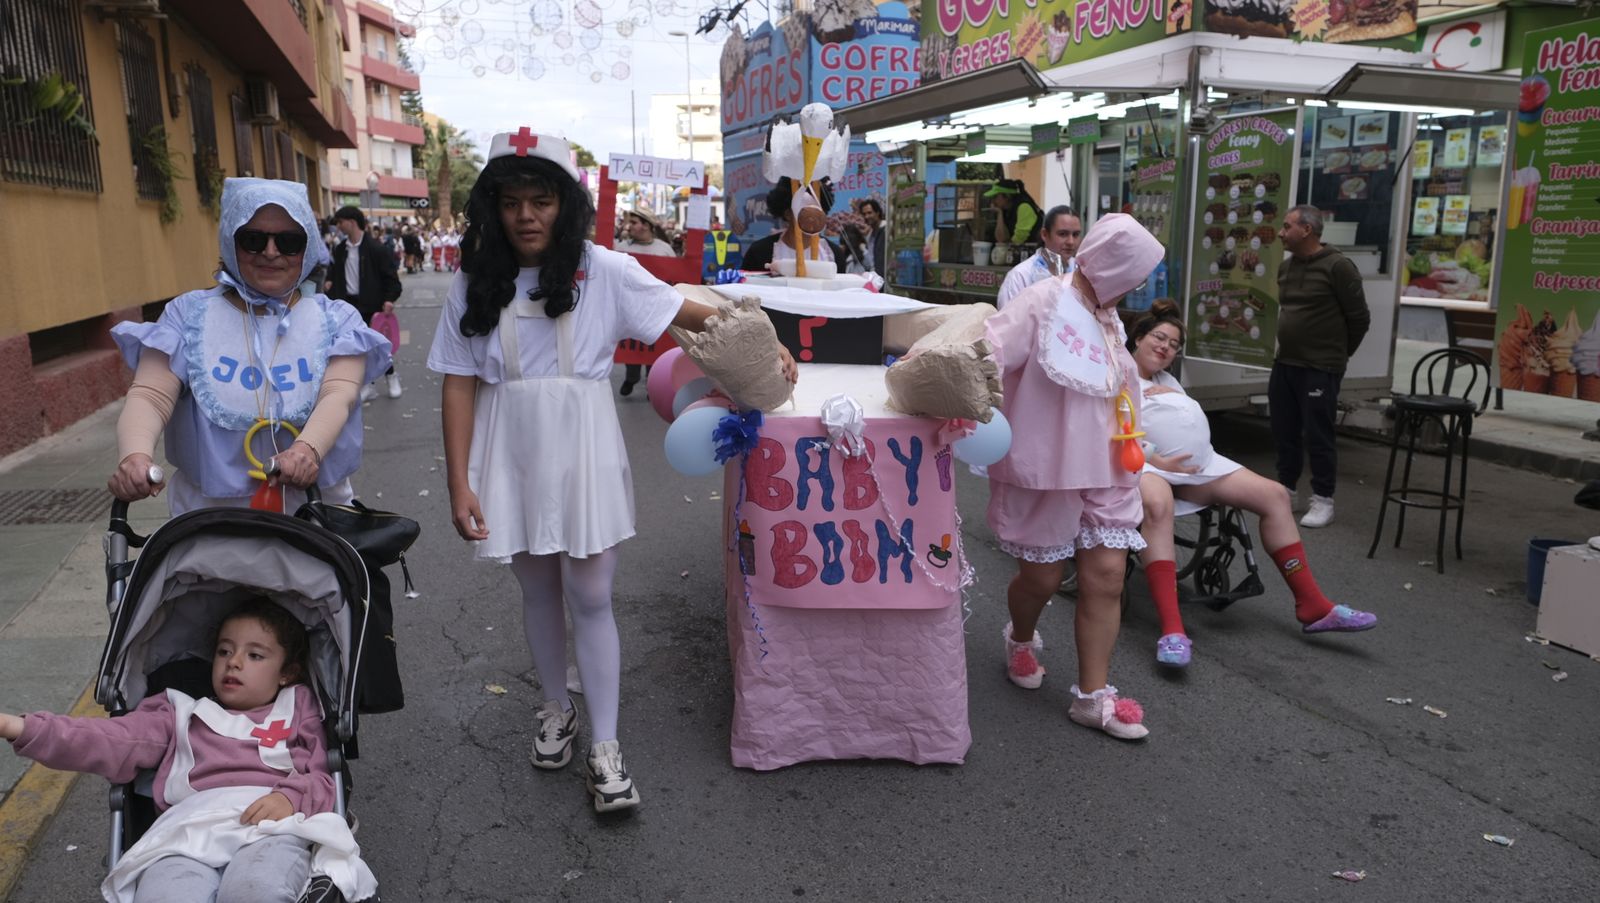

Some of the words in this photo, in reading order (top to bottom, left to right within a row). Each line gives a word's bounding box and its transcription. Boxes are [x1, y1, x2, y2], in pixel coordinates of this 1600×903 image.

[952, 31, 1011, 76] CREPES
[1537, 32, 1600, 73] Hela
[723, 49, 803, 125] GOFRES
[212, 356, 313, 392] JOEL
[745, 436, 923, 512] BABY
